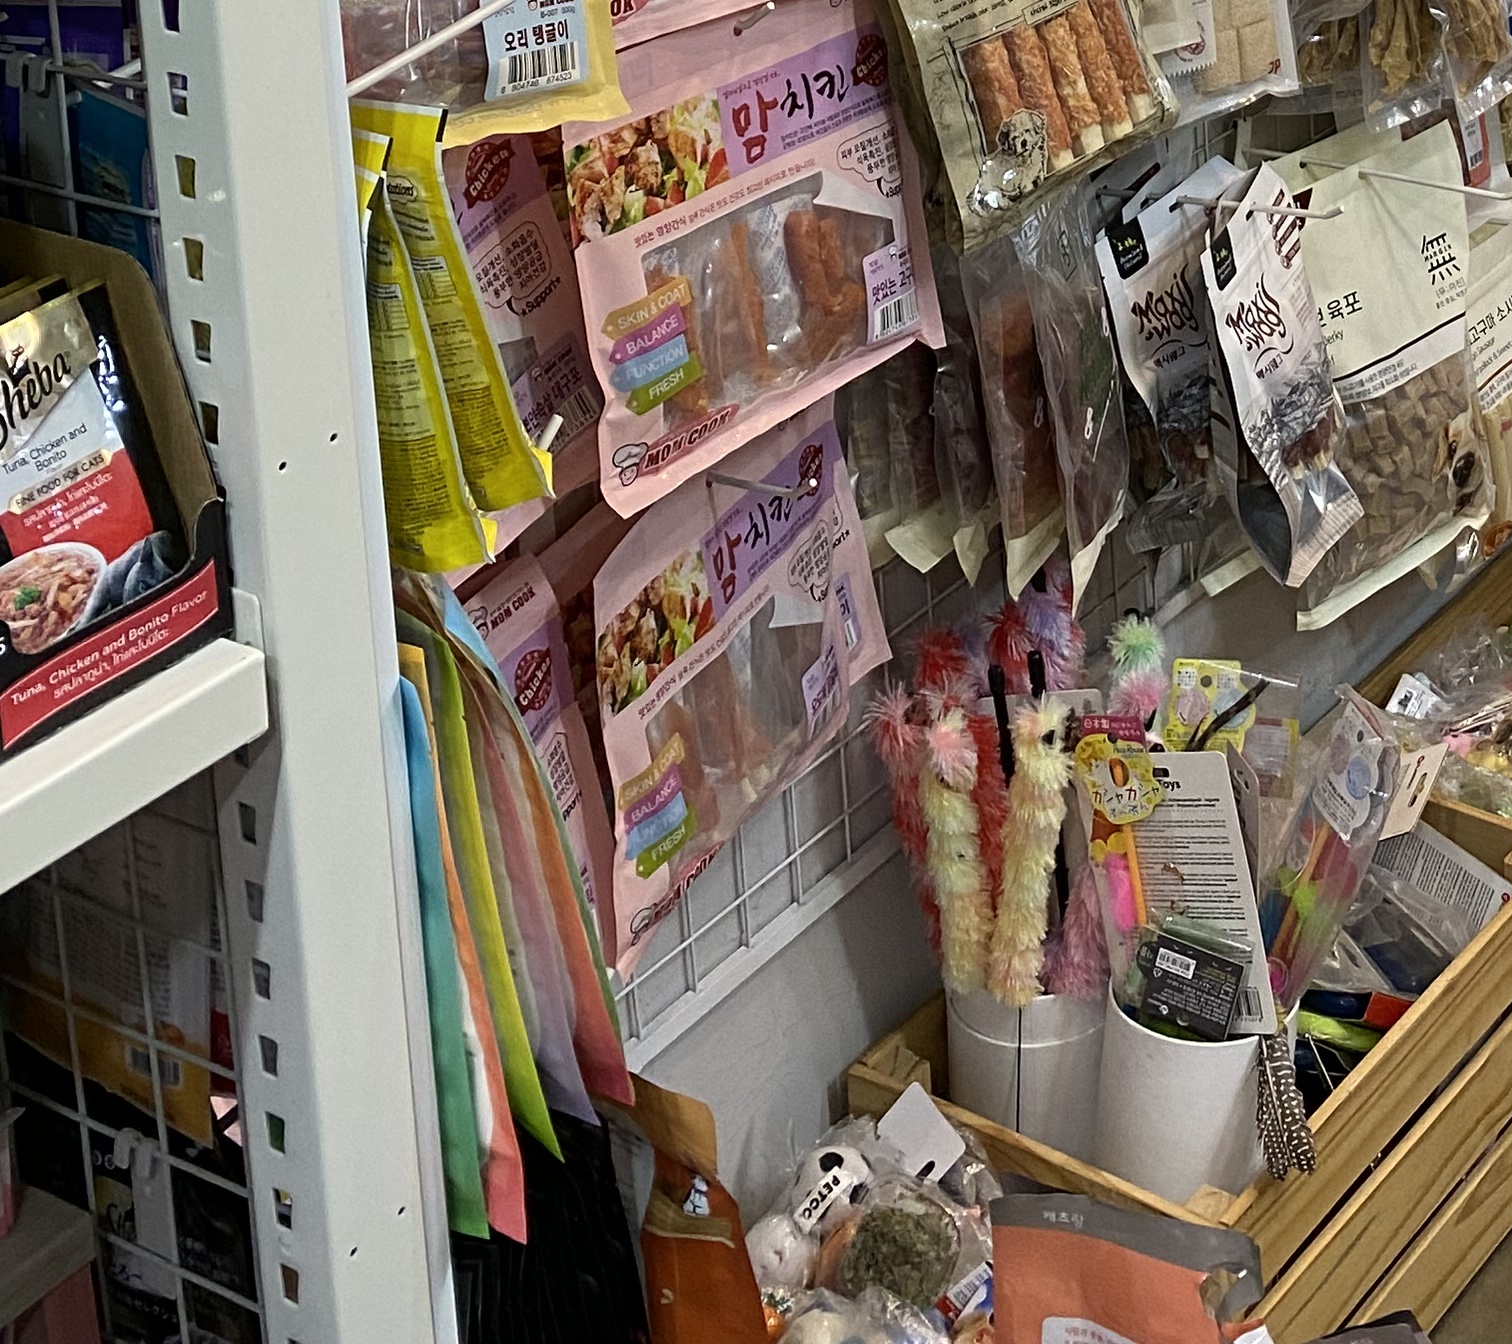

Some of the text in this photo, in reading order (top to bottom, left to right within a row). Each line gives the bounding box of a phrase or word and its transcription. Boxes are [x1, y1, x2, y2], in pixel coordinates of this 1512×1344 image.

[503, 18, 570, 52] 오리 탱글이
[467, 148, 510, 199] Chicken
[523, 278, 558, 316] Support
[617, 283, 687, 332] SKIN COAT
[871, 277, 899, 306] 맛있는
[625, 315, 679, 359] BALANCE
[625, 344, 685, 384] FUNCTION
[648, 368, 685, 402] FRESH
[1, 422, 89, 476] Tuna, Chicken and
[34, 448, 68, 472] Bonito
[644, 406, 731, 470] MOM COOK
[16, 454, 105, 509] FINE FOOD FOR CATS
[10, 589, 208, 705] Tuna, Chicken and Bonito Flavor
[629, 773, 680, 821] BALANCE
[650, 824, 687, 862] FRESH
[801, 1173, 842, 1220] PETCO
